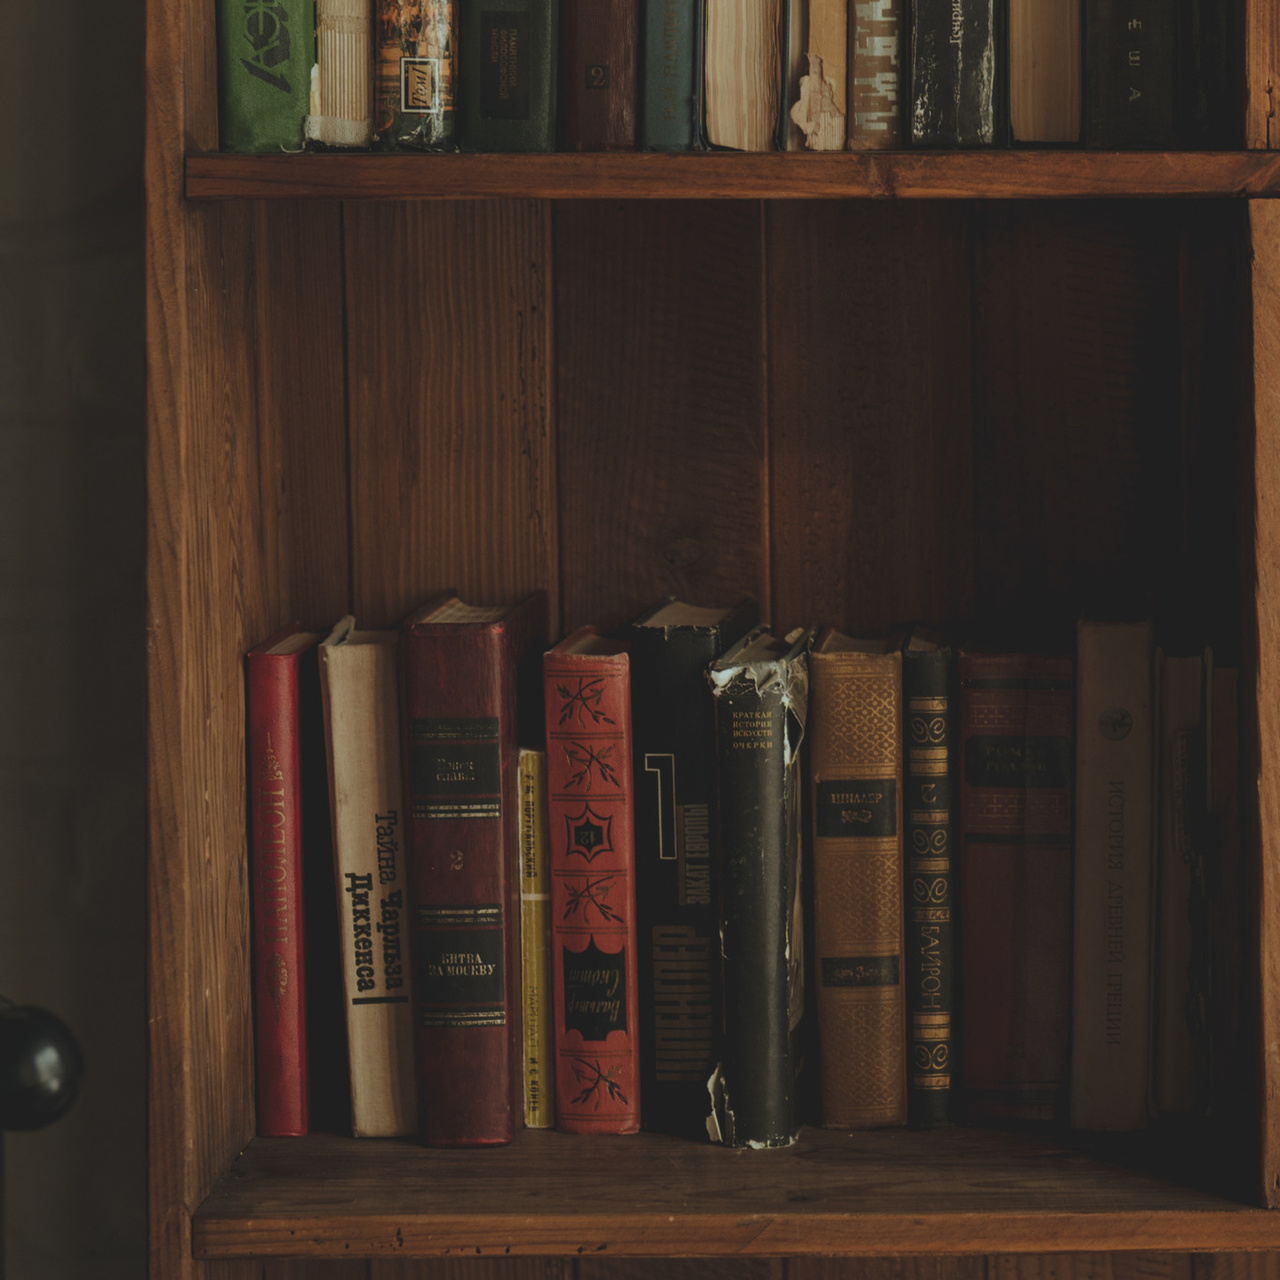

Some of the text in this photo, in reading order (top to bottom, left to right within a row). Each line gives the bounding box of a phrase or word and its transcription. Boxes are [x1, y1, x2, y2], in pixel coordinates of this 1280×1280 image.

[591, 67, 606, 87] 2
[732, 711, 773, 719] КРАТКАЯ
[732, 720, 773, 728] ИСТОРИЯ
[732, 729, 773, 738] ИСКУССТВ
[732, 740, 773, 749] ОЧЕРКИ
[920, 783, 937, 804] 2
[644, 753, 677, 860] 1
[376, 810, 399, 885] Тайна
[684, 803, 711, 905] ЗАКАТ ЕВРОПЫ
[260, 786, 289, 945] НАПОЛЕОН
[450, 849, 465, 871] 2
[1104, 780, 1125, 1046] ИСТОРИЯ ДРЕВНЕЙ ГРЕЦИИ
[345, 872, 375, 993] Диккенса
[377, 890, 404, 991] Чарльза
[441, 952, 483, 965] БИТВА
[446, 963, 496, 976] МОСКВУ
[652, 925, 713, 1082] ШПЕНГЛЕР
